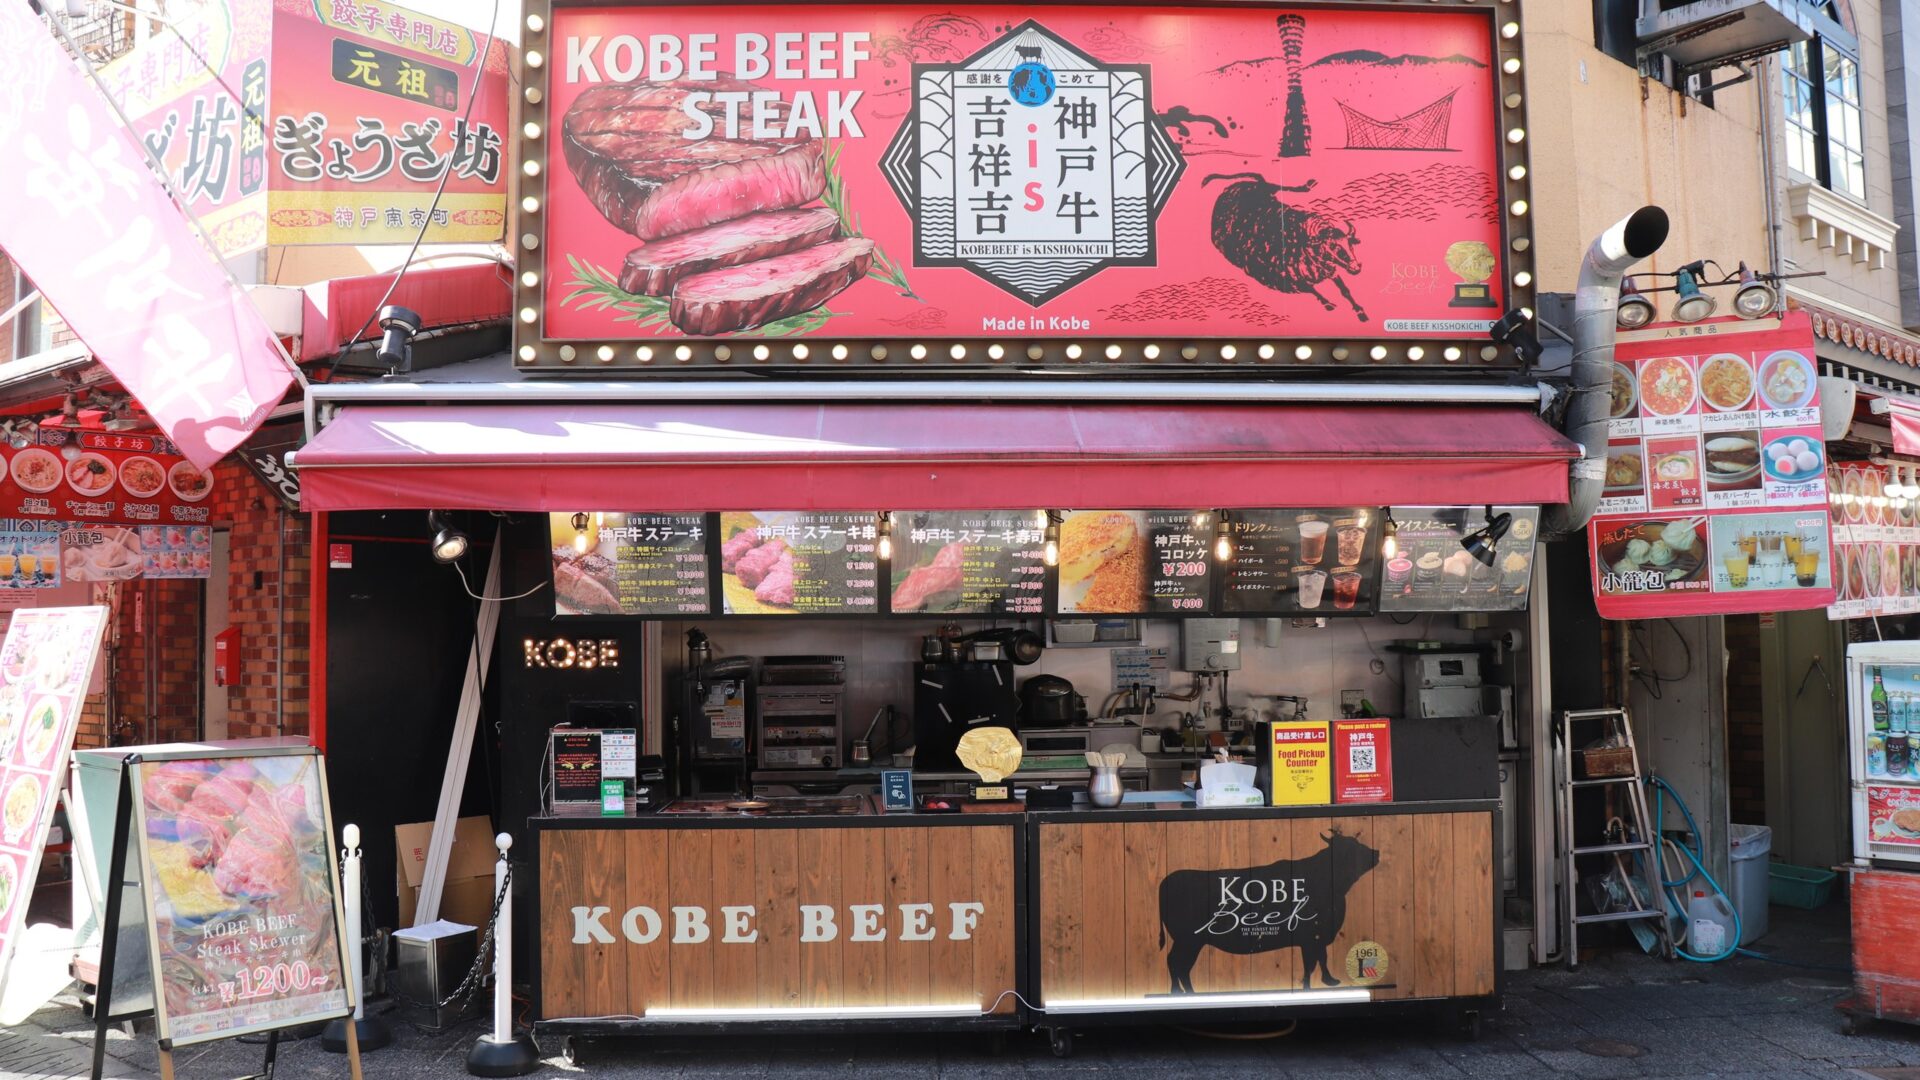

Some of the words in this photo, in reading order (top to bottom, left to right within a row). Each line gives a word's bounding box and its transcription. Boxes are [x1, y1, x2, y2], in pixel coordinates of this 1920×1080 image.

[333, 0, 459, 55] 餃子専門店
[566, 33, 718, 83] KOBE
[735, 31, 870, 80] BEEF
[347, 50, 429, 99] 元祖
[966, 73, 1002, 85] 感謝を
[1059, 73, 1095, 84] こめて
[242, 66, 265, 155] 元祖
[683, 90, 865, 140] STEAK
[274, 113, 502, 184] ぎょうざ坊
[966, 95, 1013, 235] 吉祥吉
[1053, 95, 1099, 235] 神戸牛
[335, 207, 448, 227] 神戸南京町
[960, 244, 1019, 255] KOBEBEEF
[1022, 244, 1032, 255] is
[1034, 244, 1109, 255] KISSHOKICHI
[1392, 262, 1439, 279] KOBE
[983, 317, 1025, 330] Made
[1030, 317, 1045, 330] in
[1049, 316, 1090, 330] Kobe
[1387, 321, 1408, 330] KOBE
[1410, 321, 1429, 330] BEEF
[1432, 321, 1483, 330] KISSHOKICHI
[1664, 325, 1718, 337] 人気商品
[1765, 408, 1815, 419] 水餃子
[93, 434, 145, 450] 餃子坊
[627, 517, 647, 525] KOBE
[651, 517, 672, 525] BEEF
[675, 516, 701, 525] STEAK
[843, 515, 875, 523] SKEWER
[962, 519, 988, 527] KOBE
[990, 519, 1014, 527] BEEF
[1191, 515, 1211, 523] BF
[64, 530, 104, 545] 小籠包
[1160, 549, 1207, 560] コロッケ
[1163, 561, 1206, 576] ¥200
[1602, 571, 1666, 593] 小籠包
[1172, 598, 1203, 608] ¥400
[524, 639, 619, 668] KOBE
[1276, 731, 1325, 740] 商品受け渡し口
[1350, 732, 1375, 741] 神戸牛
[1278, 750, 1297, 759] Food
[1298, 749, 1325, 759] Pickup
[1286, 759, 1318, 767] Counter
[1219, 876, 1305, 904] KOBE
[1194, 895, 1318, 934] Beef
[203, 920, 249, 939] KOBE
[255, 914, 298, 931] BEEF
[571, 905, 758, 944] KOBE
[800, 902, 985, 942] BEEF
[197, 942, 242, 959] Steak
[249, 933, 306, 950] Skewer
[1355, 949, 1378, 958] 1961
